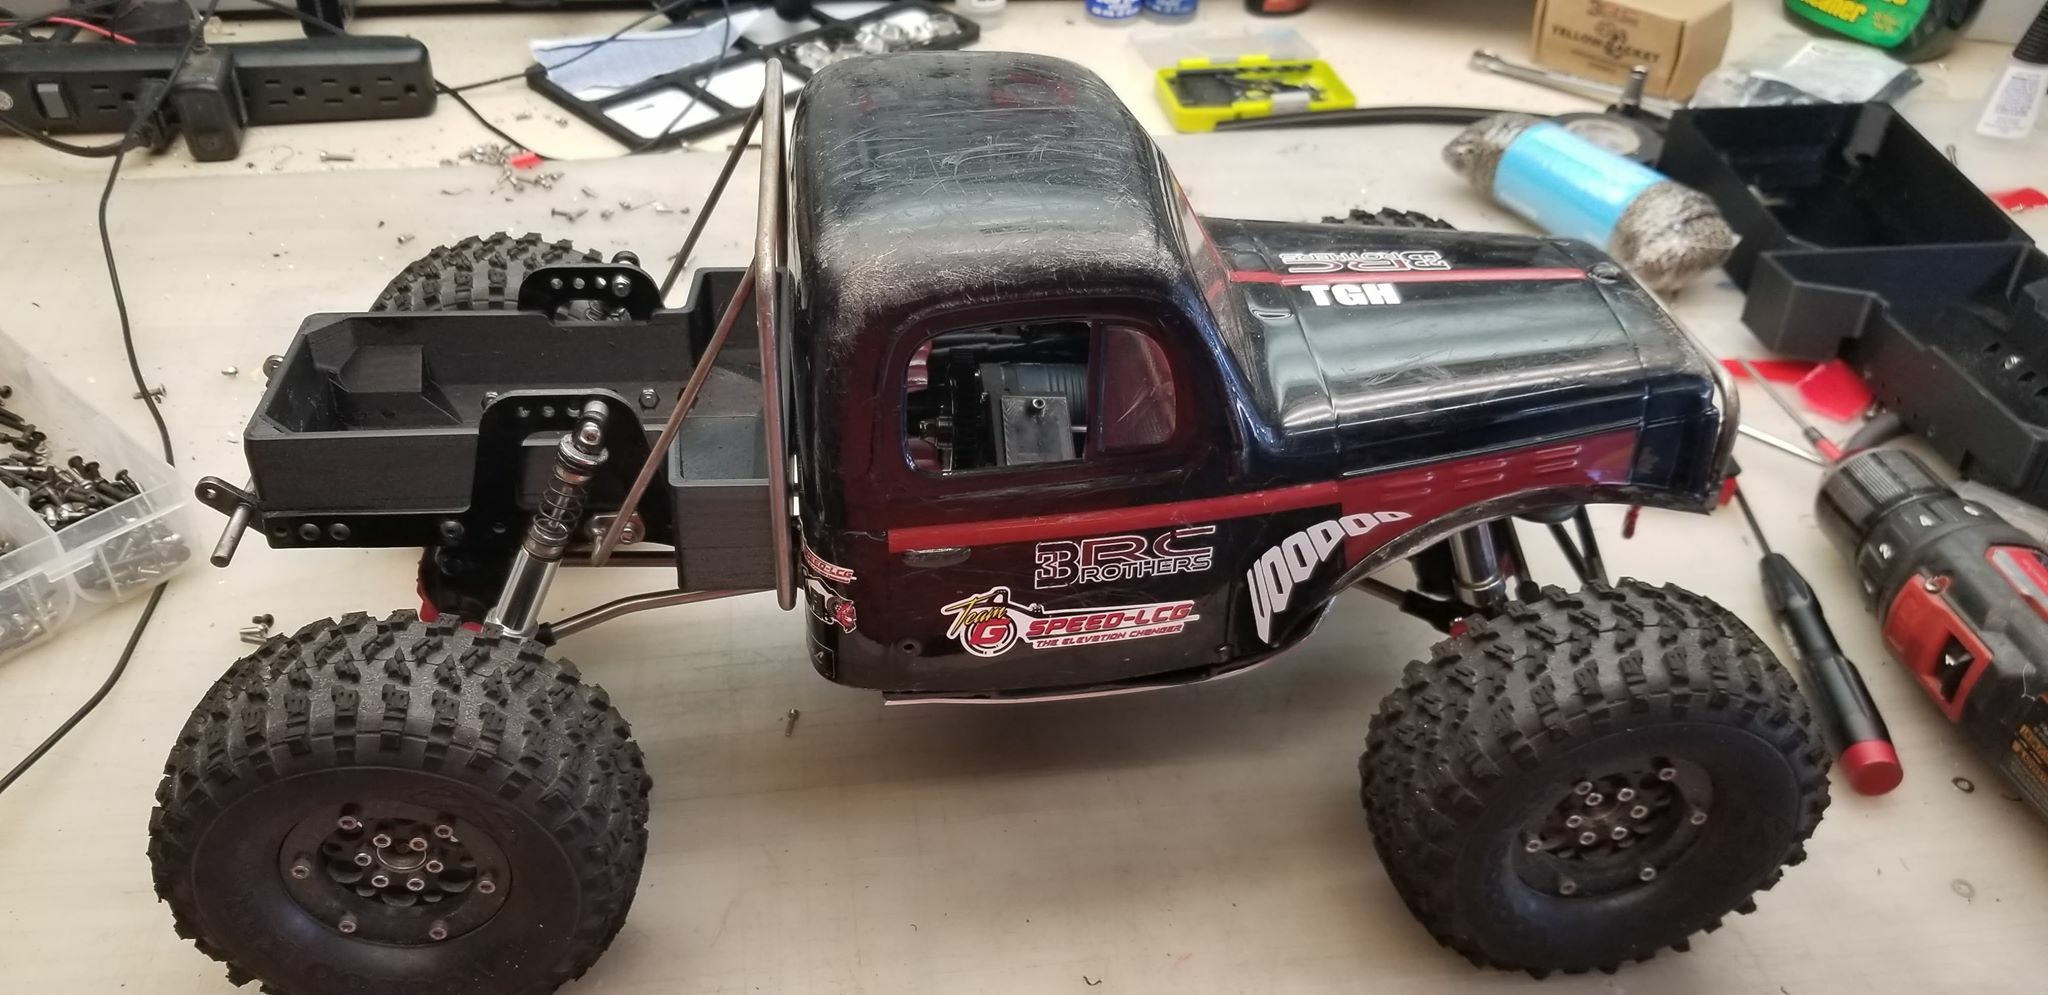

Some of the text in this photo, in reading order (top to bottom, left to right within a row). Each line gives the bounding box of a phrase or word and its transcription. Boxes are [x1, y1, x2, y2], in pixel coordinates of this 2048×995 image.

[1301, 283, 1401, 306] TGH
[1246, 511, 1412, 644] VOODOO
[945, 591, 1007, 636] Team
[1026, 603, 1193, 637] SPEED-LCG
[1035, 624, 1183, 648] THE ELEVATION CHANGER
